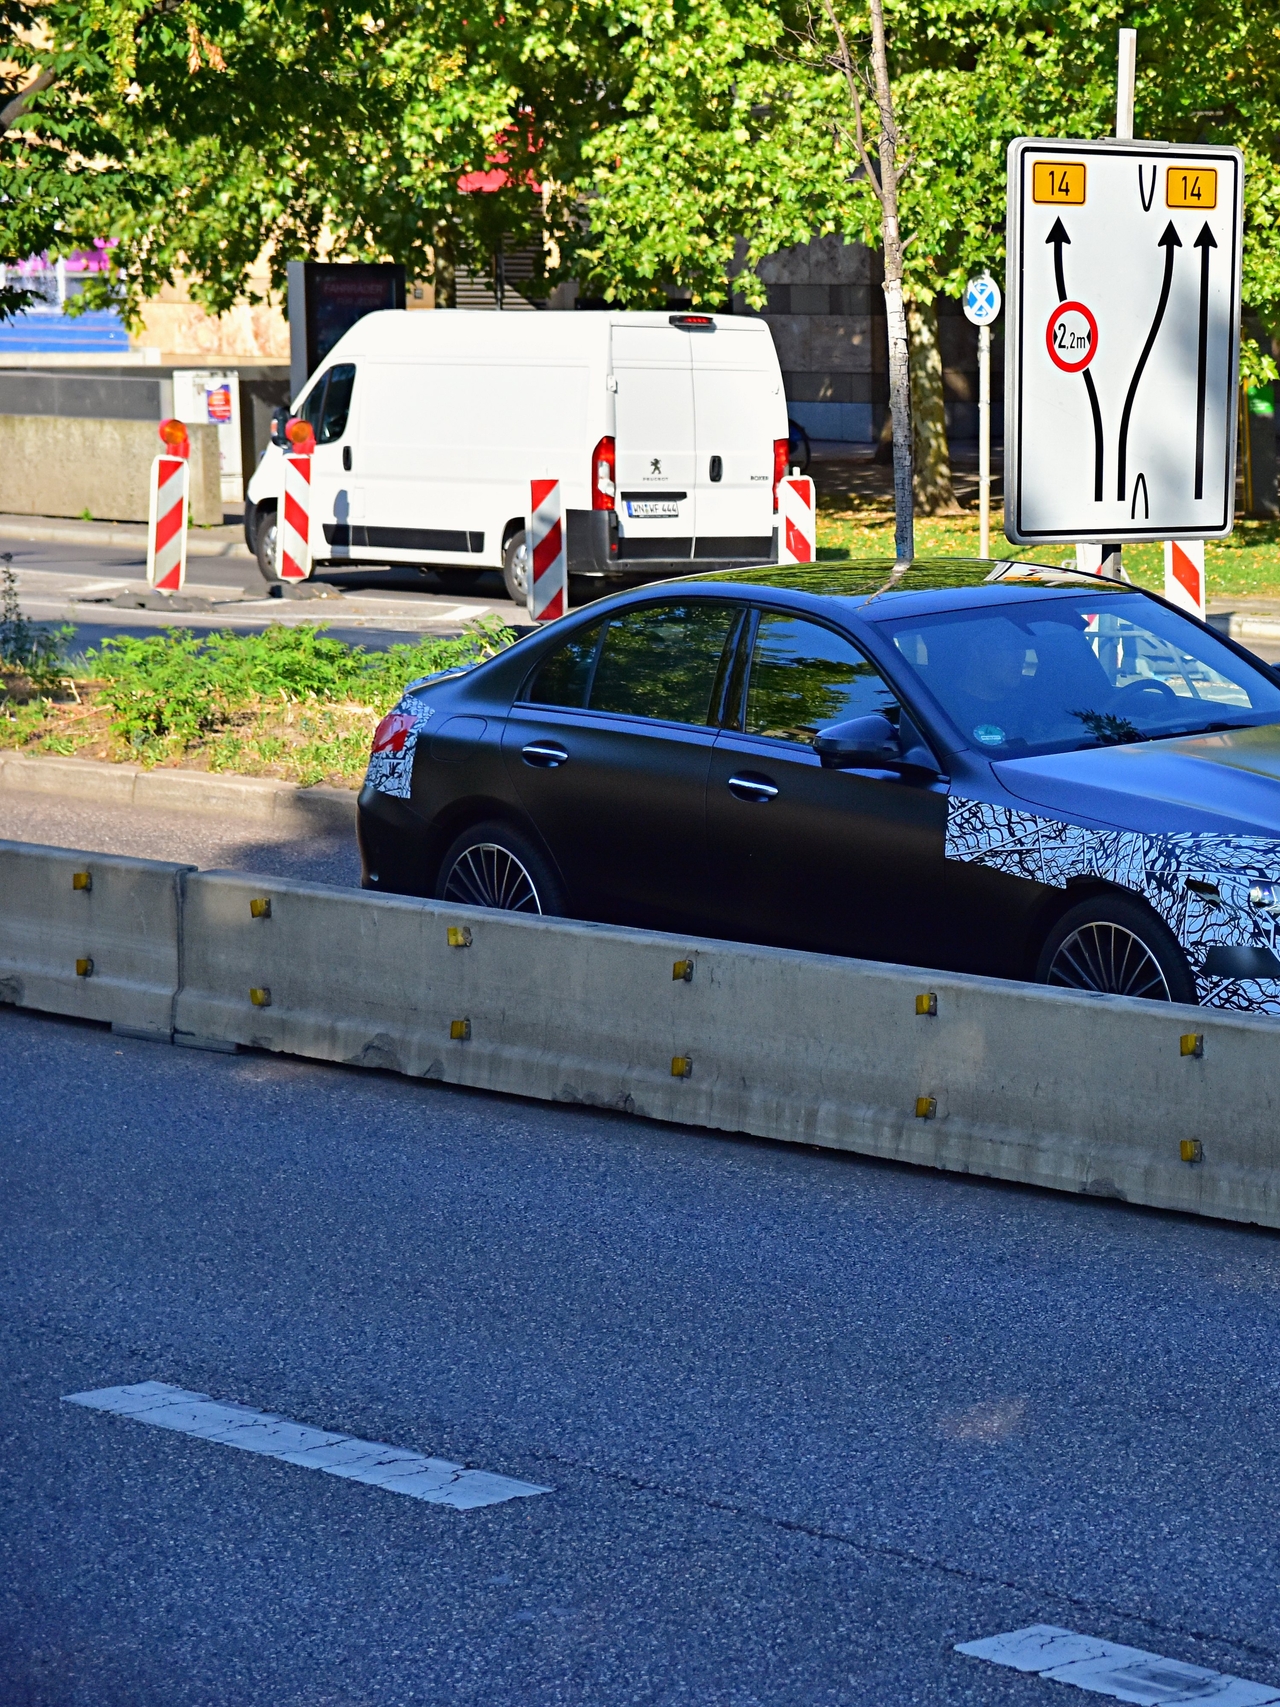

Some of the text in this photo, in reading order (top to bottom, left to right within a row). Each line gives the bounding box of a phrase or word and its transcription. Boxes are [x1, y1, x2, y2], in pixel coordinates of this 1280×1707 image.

[1049, 170, 1070, 196] 14
[1181, 175, 1202, 201] 14
[661, 503, 677, 514] 444
